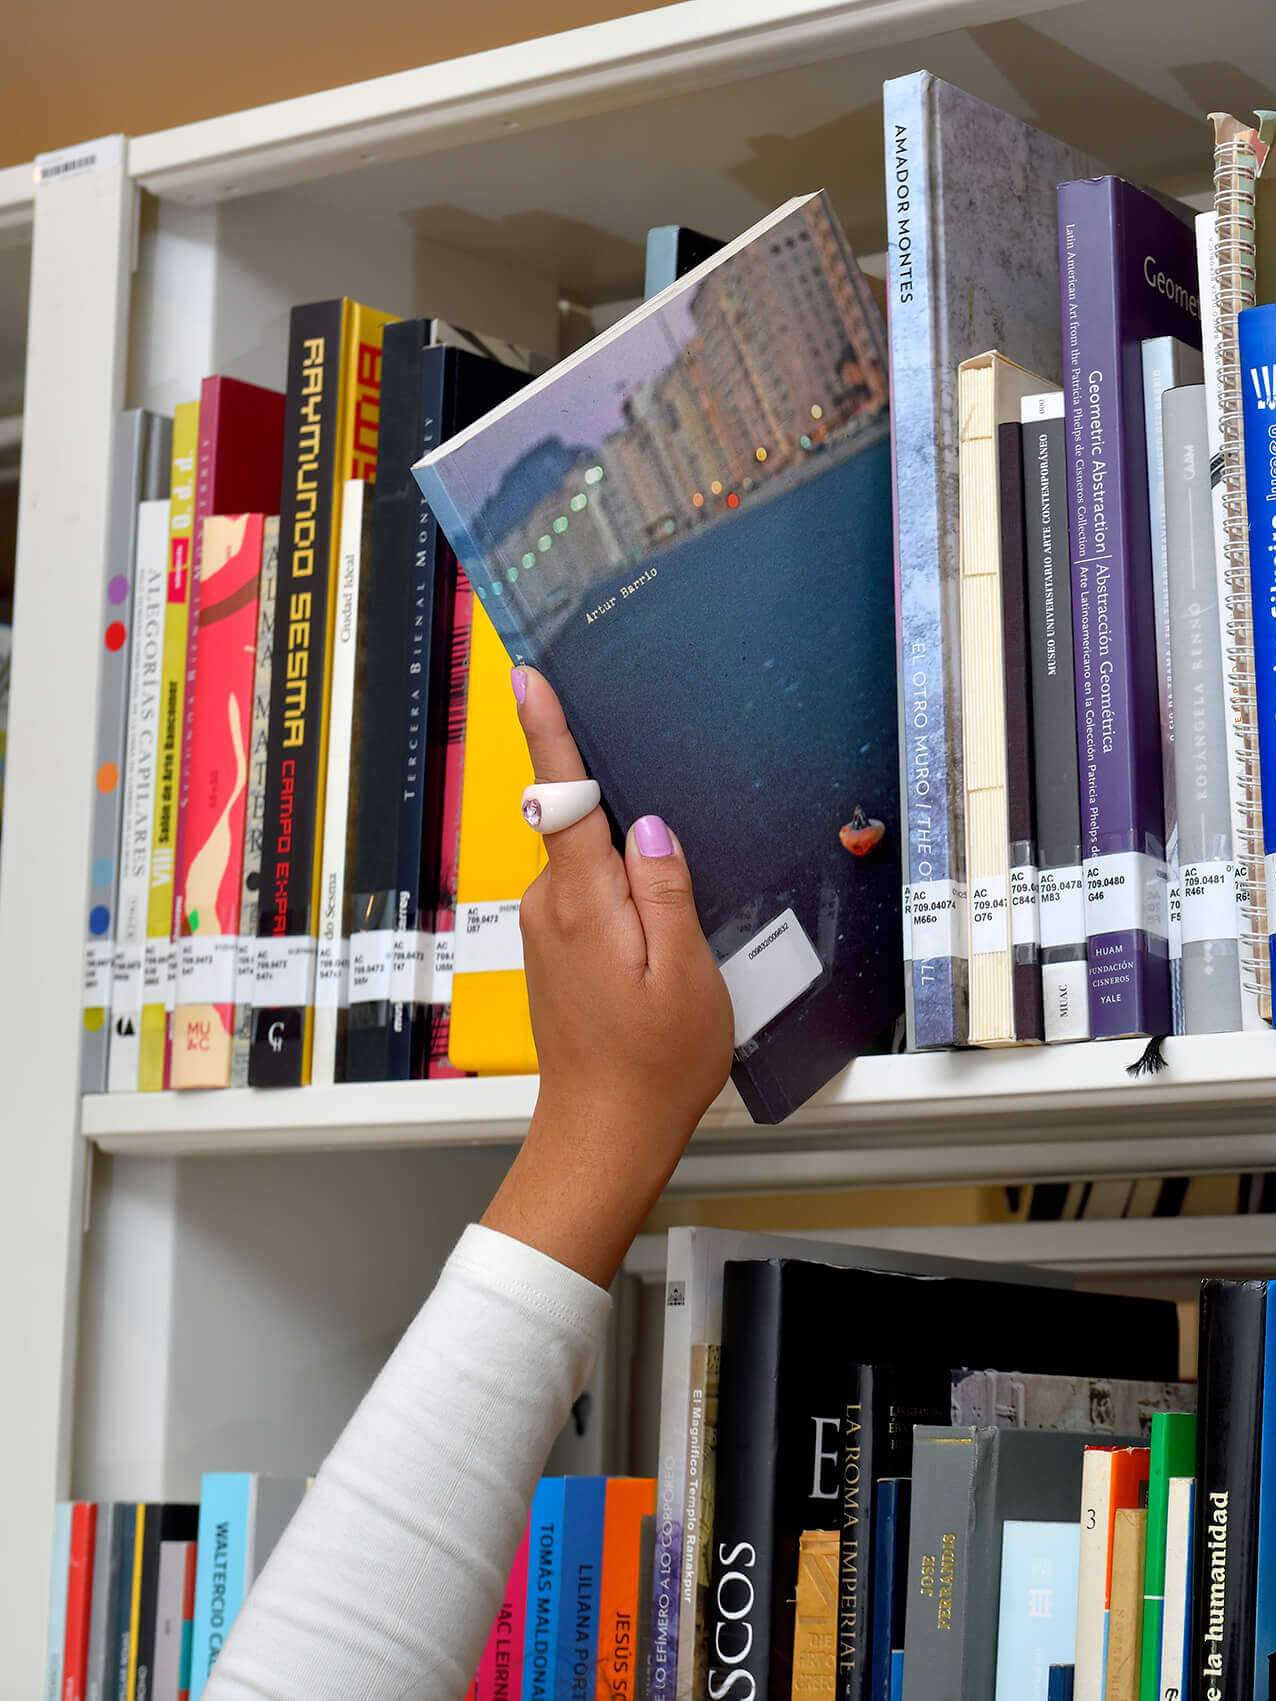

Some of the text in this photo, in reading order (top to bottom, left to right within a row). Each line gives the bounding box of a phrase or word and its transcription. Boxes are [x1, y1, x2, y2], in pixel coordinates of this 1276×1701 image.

[894, 124, 914, 304] AMADOR MONTES
[1065, 222, 1087, 557] Latin American Art from the Patricia Phelps de Cisneros Collection
[276, 337, 326, 853] RAYMUNDO SESMA CAMPO
[340, 553, 355, 644] Ciudad Ideal
[586, 567, 657, 624] Artur Barrio
[1038, 433, 1056, 676] MUSEO UNIVERSITARIO ARTE CONTEMPORÁNEO
[1088, 369, 1114, 753] Geometric Abstraction Abstracción Geométrica
[142, 566, 164, 720] ALEGORÍAS
[404, 582, 426, 801] TERCERA BIENAL
[911, 642, 933, 855] EL OTRO MURO THE
[131, 728, 153, 879] CAPILARES
[1086, 868, 1100, 877] AC
[1087, 876, 1125, 889] 709.0480
[1087, 891, 1105, 902] G46
[1059, 983, 1069, 1018] MUAC
[1088, 960, 1135, 976] FUNDACIÓN
[1092, 975, 1131, 988] CISNEROS
[1095, 944, 1123, 957] HUAM
[1099, 993, 1122, 1005] YALE
[683, 1389, 703, 1603] El Magnífico Templo Ranakpur
[839, 1404, 863, 1676] LA ROMA IMPERIAL
[209, 1521, 230, 1630] WALTERCIO
[537, 1523, 555, 1593] TOMÁS
[574, 1564, 594, 1644] LILIANA
[1203, 1490, 1230, 1678] la humanidad
[612, 1611, 632, 1674] JESÚS
